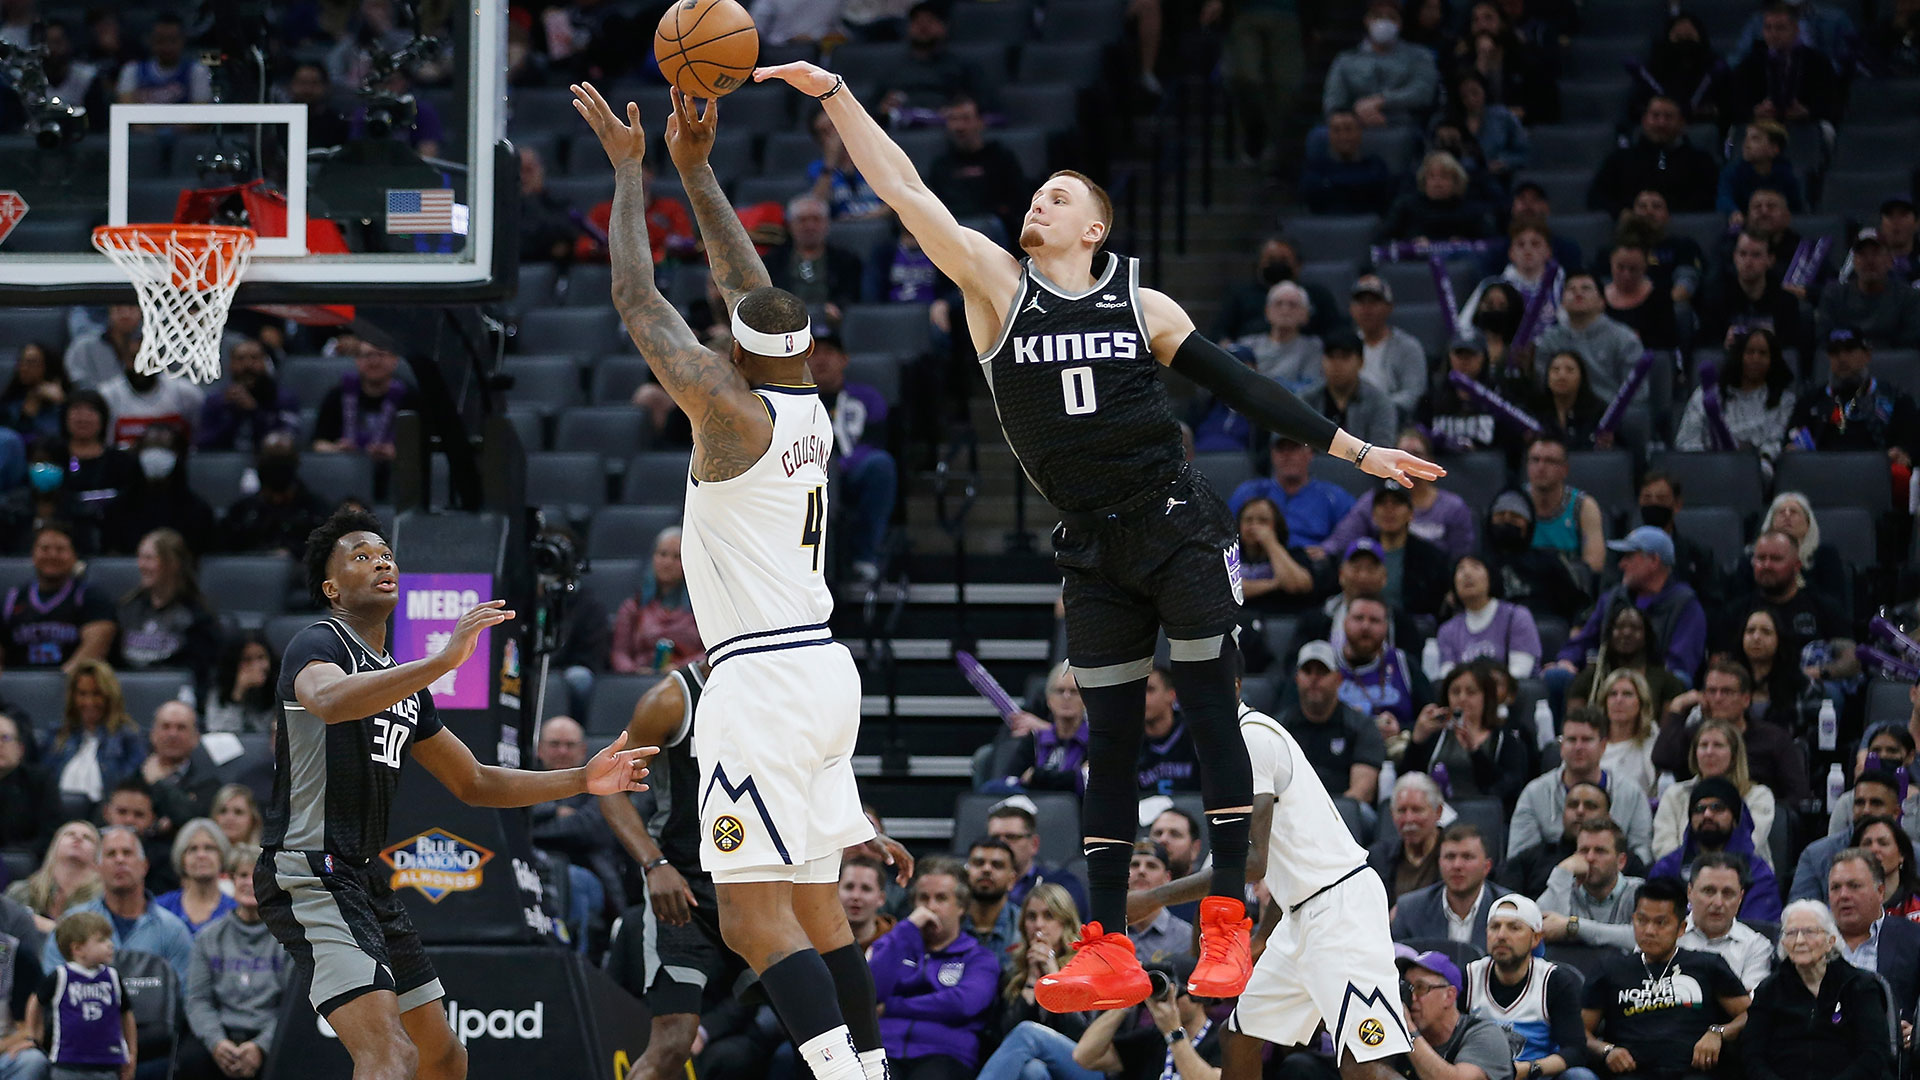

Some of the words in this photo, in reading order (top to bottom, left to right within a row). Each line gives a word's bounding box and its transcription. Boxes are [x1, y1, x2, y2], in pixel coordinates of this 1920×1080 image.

[1095, 301, 1128, 310] dialpad
[1013, 333, 1137, 363] KINGS
[1061, 367, 1097, 415] 0
[799, 484, 824, 573] 4
[370, 717, 411, 769] 30
[394, 850, 481, 870] DIAMOND
[416, 836, 459, 855] BLUE
[398, 870, 477, 888] ALMONDS
[317, 1000, 543, 1046] lpad
